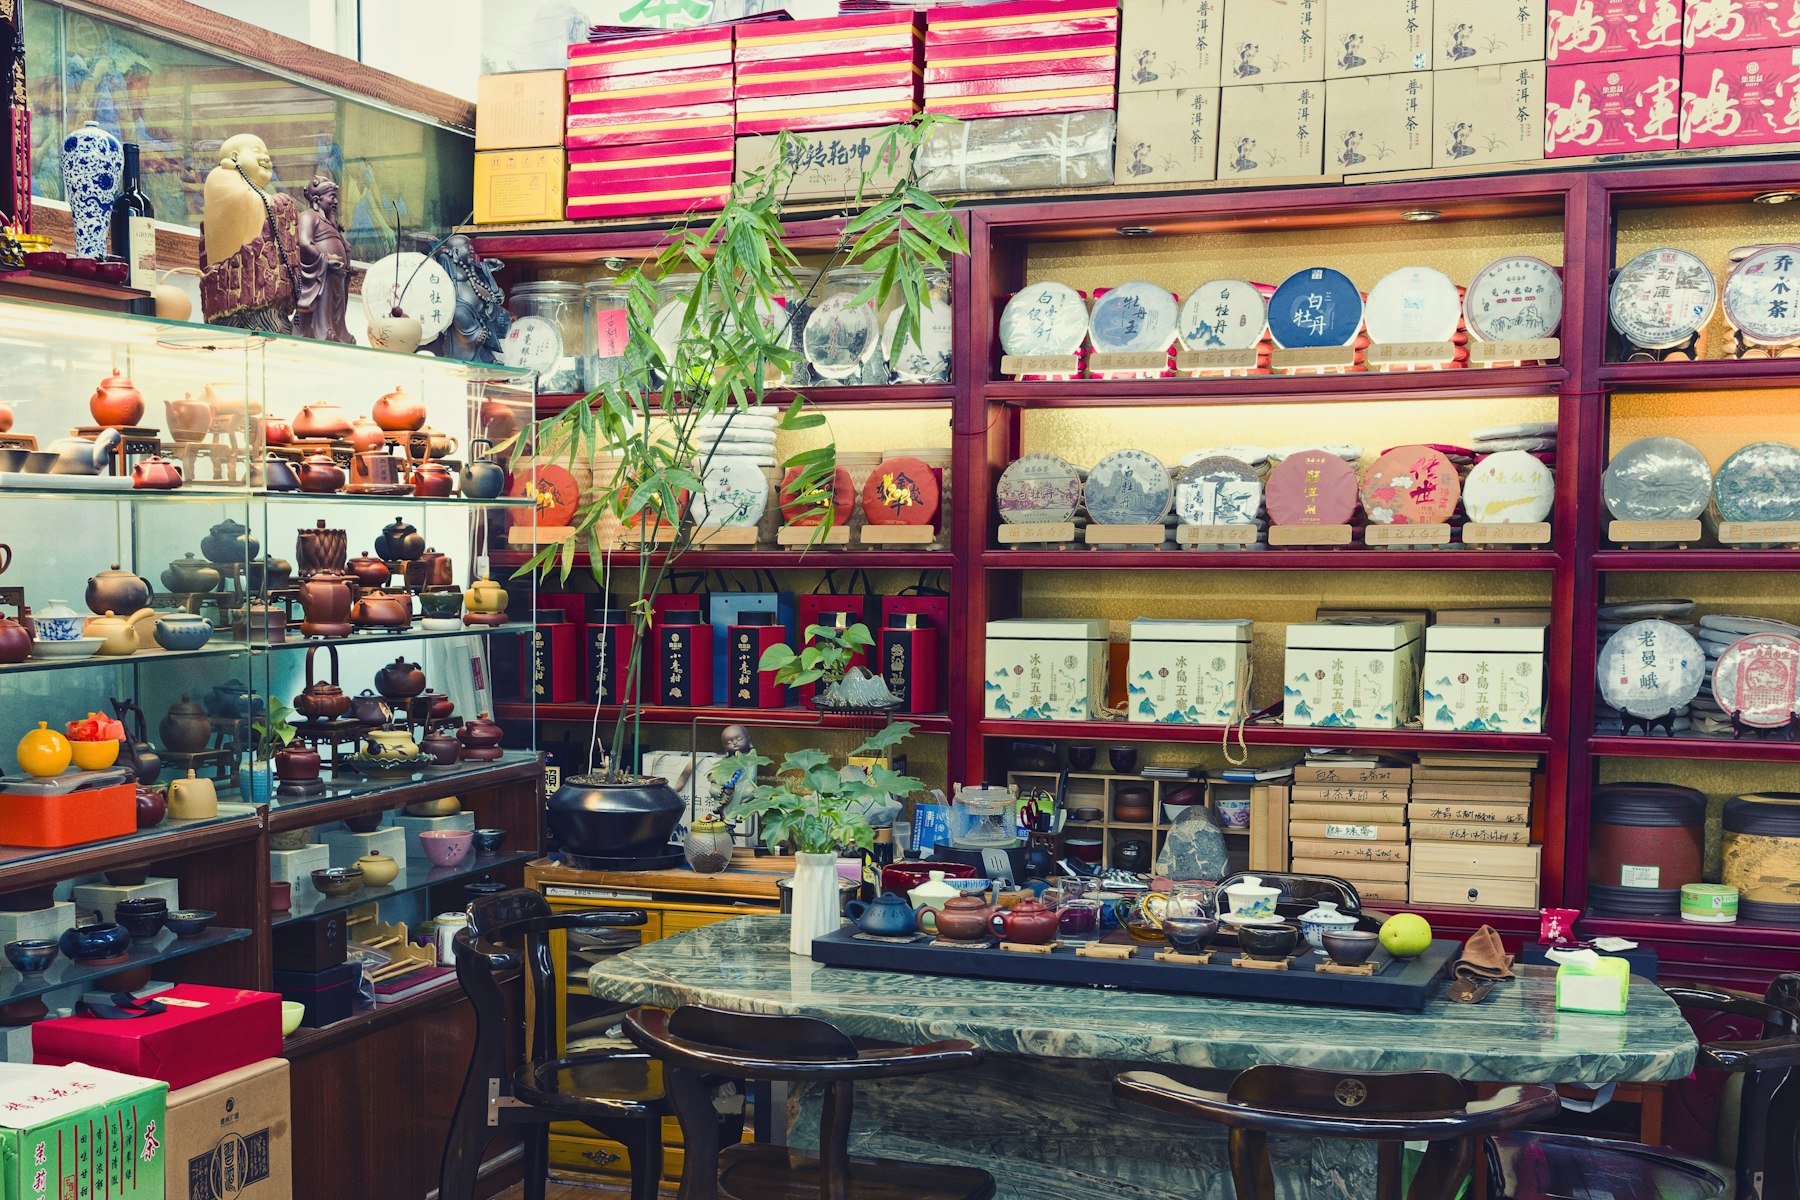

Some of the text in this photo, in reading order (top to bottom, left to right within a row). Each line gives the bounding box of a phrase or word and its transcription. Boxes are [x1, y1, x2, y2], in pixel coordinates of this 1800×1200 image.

[1196, 0, 1210, 51] 普洱茶
[1190, 94, 1205, 145] 普洱茶
[1296, 89, 1311, 140] 普洱茶
[1405, 78, 1419, 131] 普洱茶
[1516, 69, 1530, 122] 普洱茶
[430, 274, 441, 324] 白牡丹
[1123, 295, 1148, 335] 牡丹王
[1214, 288, 1230, 334] 白牡丹
[1293, 293, 1326, 336] 白牡丹
[670, 653, 681, 683] 小青柑
[739, 654, 750, 685] 小青柑
[1638, 630, 1659, 690] 老曼峨
[140, 1120, 160, 1162] 茶
[33, 1141, 46, 1200] 茉莉
